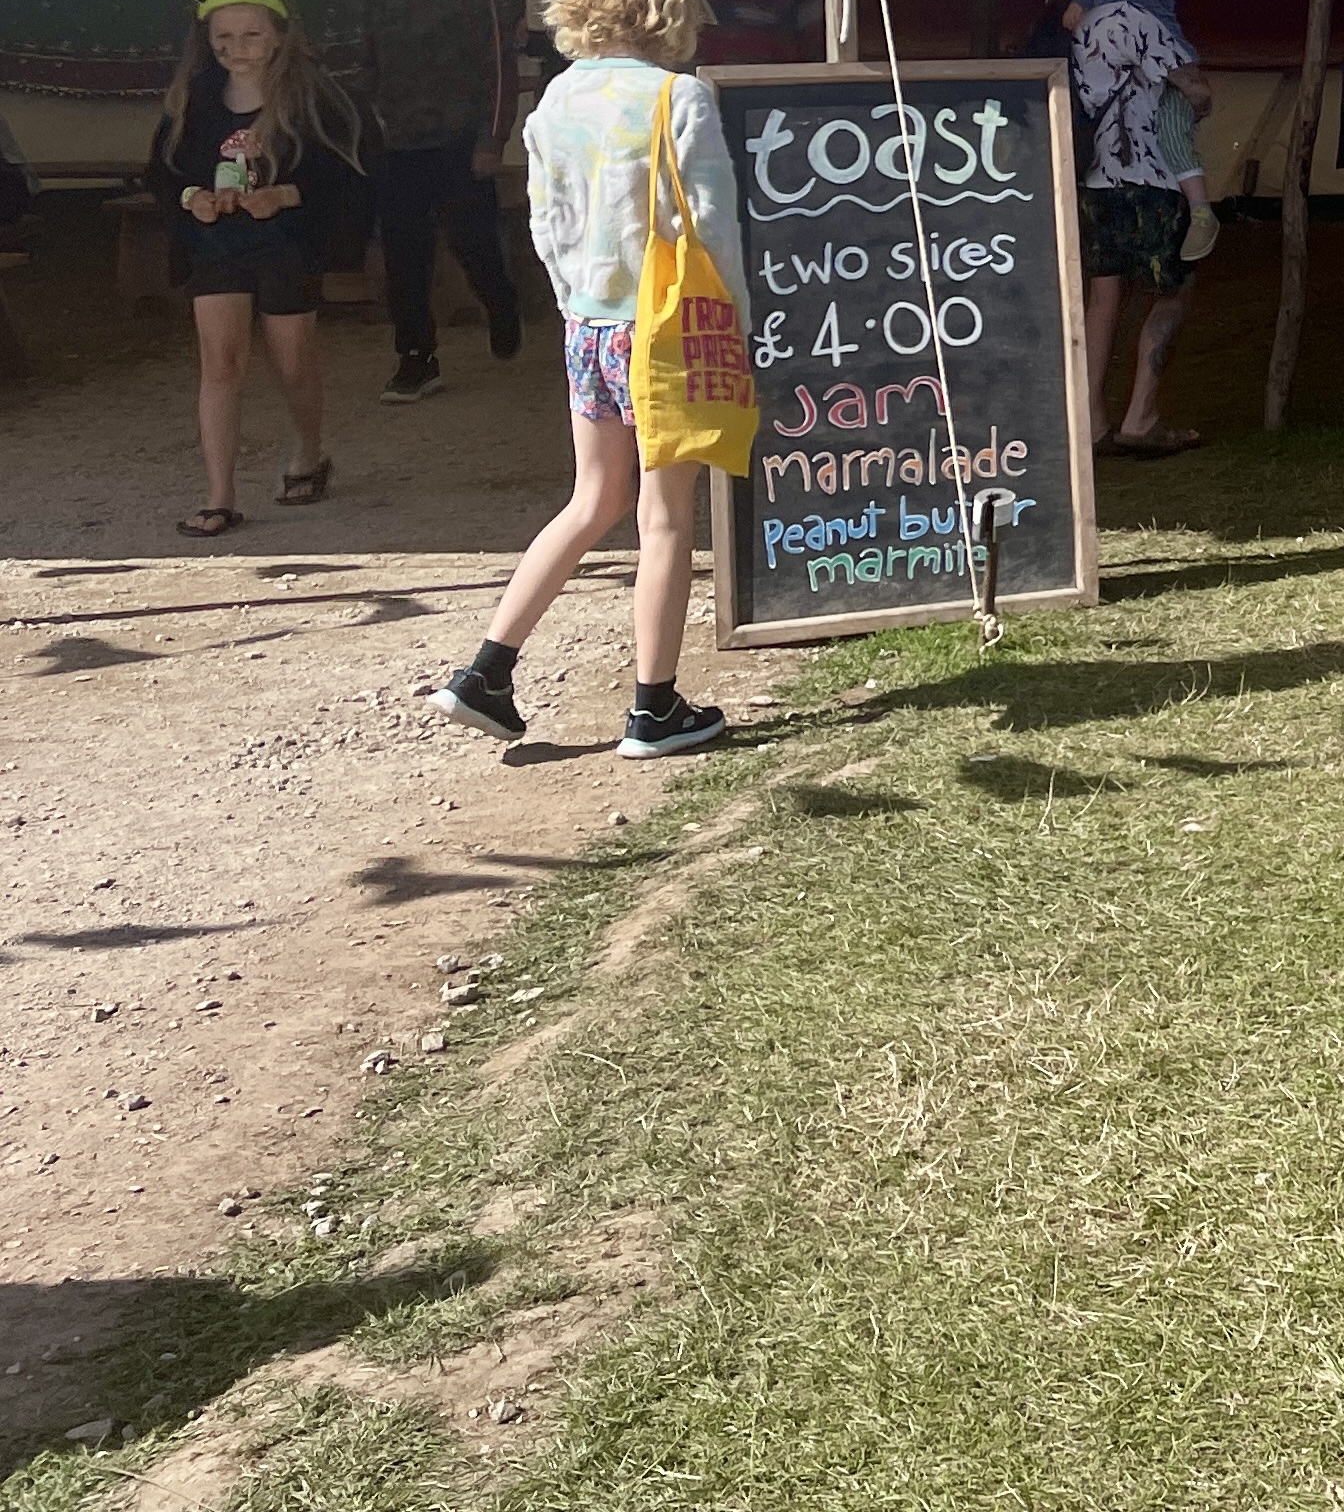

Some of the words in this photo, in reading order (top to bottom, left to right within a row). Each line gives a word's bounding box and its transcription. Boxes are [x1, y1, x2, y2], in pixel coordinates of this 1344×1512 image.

[745, 98, 1017, 204] toast
[758, 241, 869, 296] two
[886, 231, 1017, 283] sices
[762, 425, 1029, 503] marmalade
[899, 494, 1037, 542] butr
